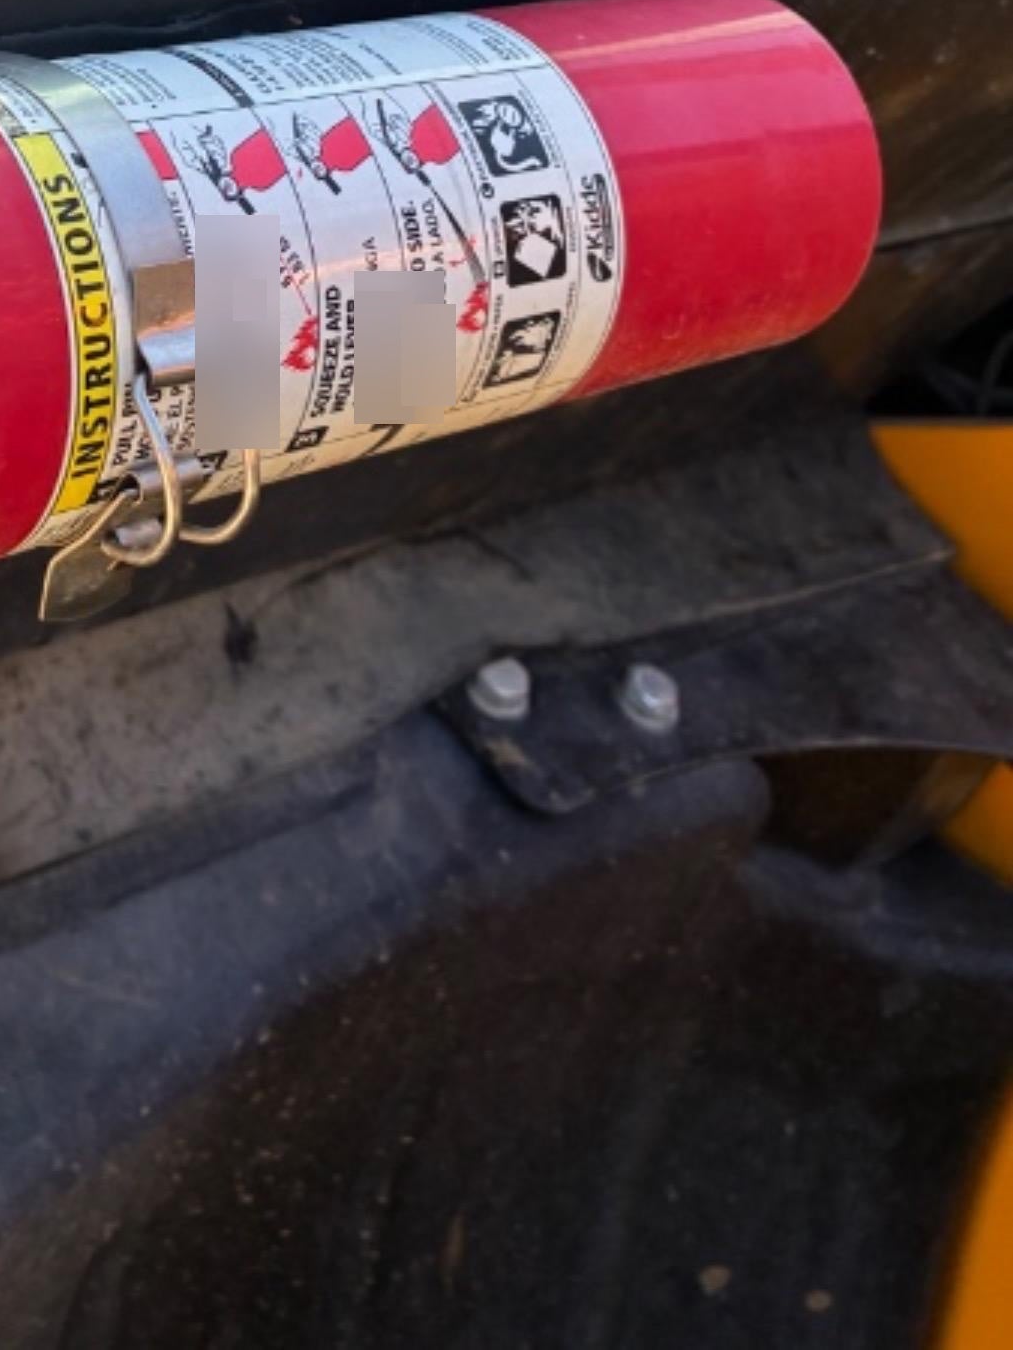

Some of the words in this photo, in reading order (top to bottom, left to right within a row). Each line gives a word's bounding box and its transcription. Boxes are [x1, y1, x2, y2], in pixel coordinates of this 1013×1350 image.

[401, 200, 422, 252] SIDE.
[44, 173, 111, 478] INSTRUCTIONS
[325, 285, 341, 332] AND
[310, 336, 341, 418] SQUEEZE
[113, 419, 137, 465] PULL
